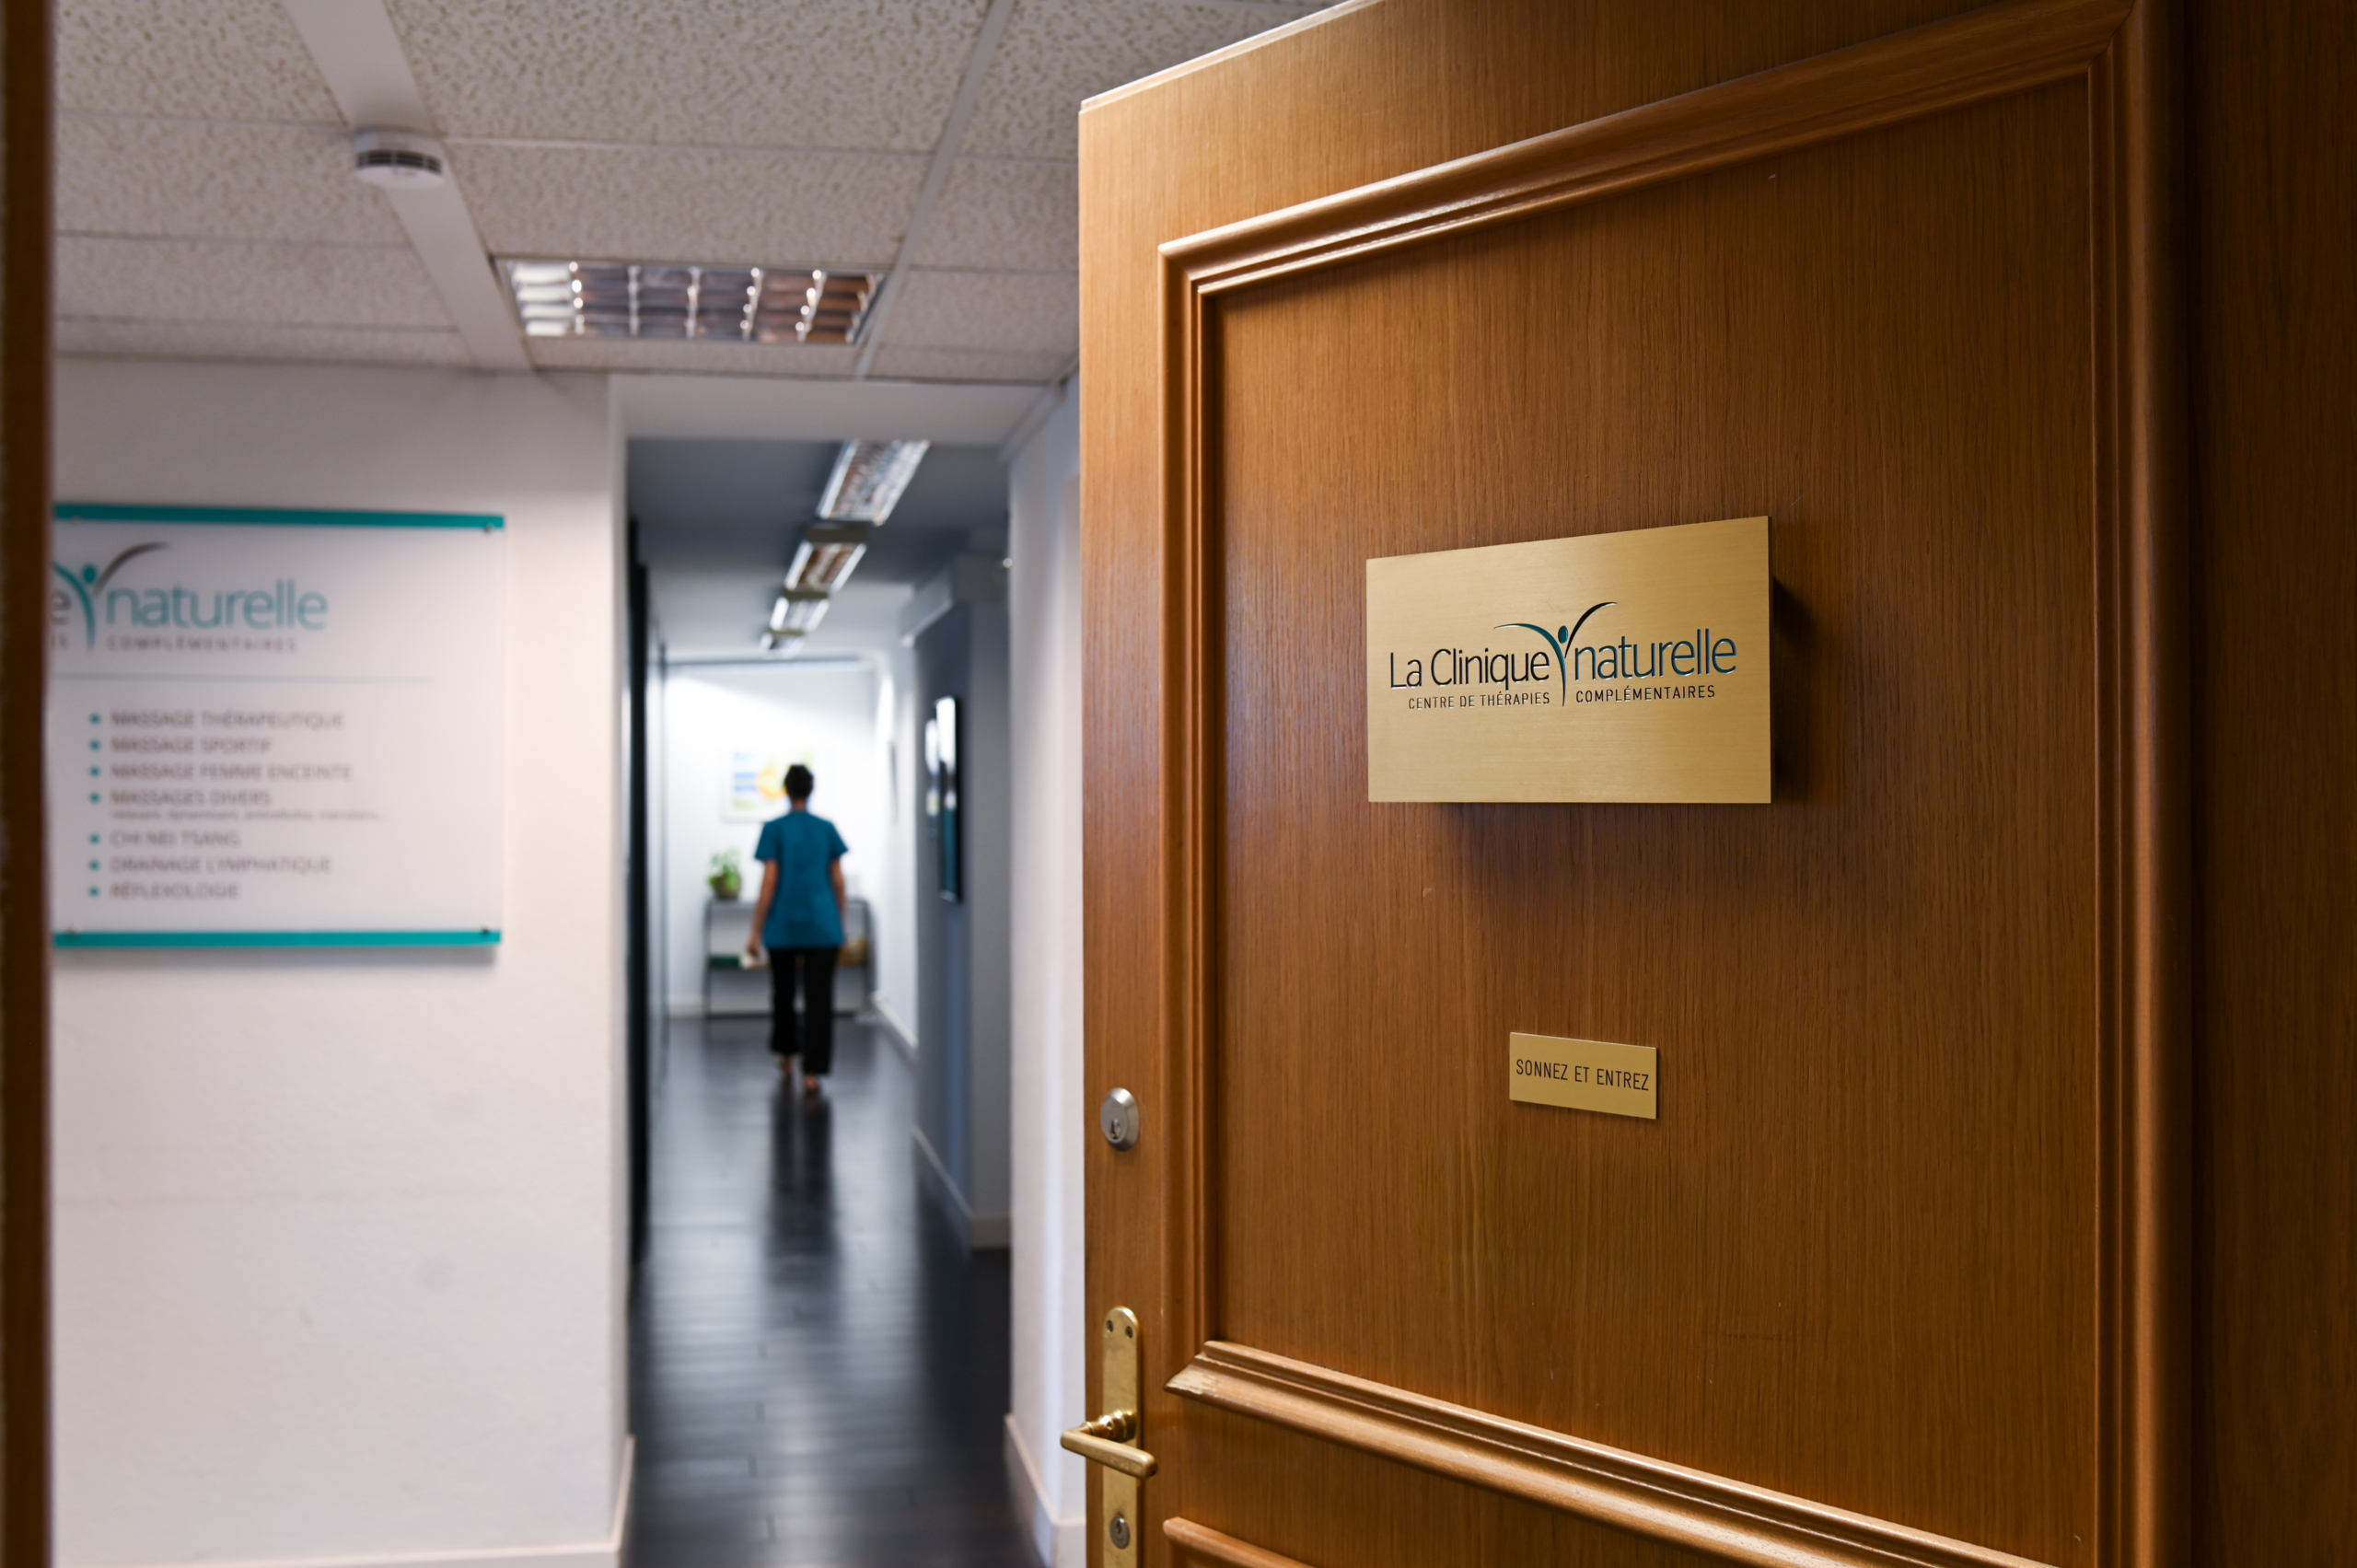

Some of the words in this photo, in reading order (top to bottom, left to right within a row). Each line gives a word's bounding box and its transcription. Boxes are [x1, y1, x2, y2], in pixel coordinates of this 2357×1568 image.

[106, 578, 329, 631] naturelle
[1389, 651, 1422, 690] La
[1431, 647, 1550, 691] Clinique
[1574, 628, 1737, 682] naturelle
[1408, 695, 1455, 710] CENTRE
[1459, 694, 1476, 708] DE
[1480, 691, 1550, 707] THÉRAPIES
[1575, 683, 1716, 704] COMPLÉMENTAIRES
[111, 711, 193, 728] MASSAGE
[201, 708, 343, 730] THÉRAPEUTIQUE
[111, 738, 193, 754] MASSAGE
[201, 738, 271, 753] SPORTIF
[111, 763, 193, 780] MASSAGE
[200, 763, 261, 780] FEMME
[268, 763, 351, 780] ENCEINTE
[111, 789, 204, 806] MASSAGES
[209, 789, 273, 806] DIVERS
[181, 830, 240, 848] TSANG
[110, 855, 200, 873] DRAINAGE
[205, 855, 332, 876] LYMPHATIQUE
[110, 879, 239, 900] RÉFLEXOLOGIE
[1515, 1059, 1568, 1081] SONNEZ
[1574, 1065, 1590, 1083] ET
[1596, 1068, 1649, 1091] ENTREZ
